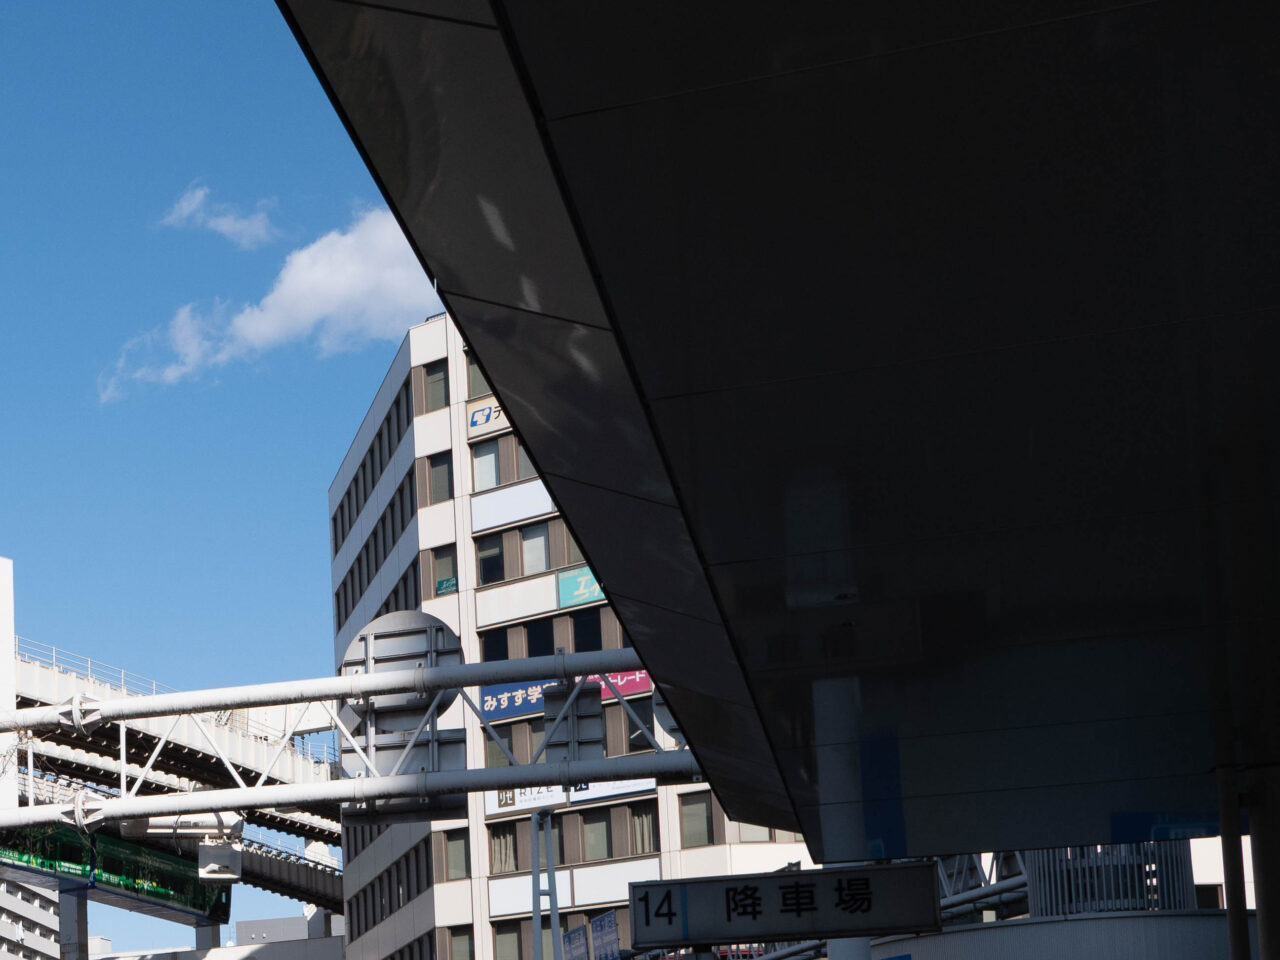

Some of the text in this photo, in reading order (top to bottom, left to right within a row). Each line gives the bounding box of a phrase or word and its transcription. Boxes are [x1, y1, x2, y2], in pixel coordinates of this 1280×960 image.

[483, 682, 558, 712] みすず学
[637, 876, 873, 927] 14 降車場
